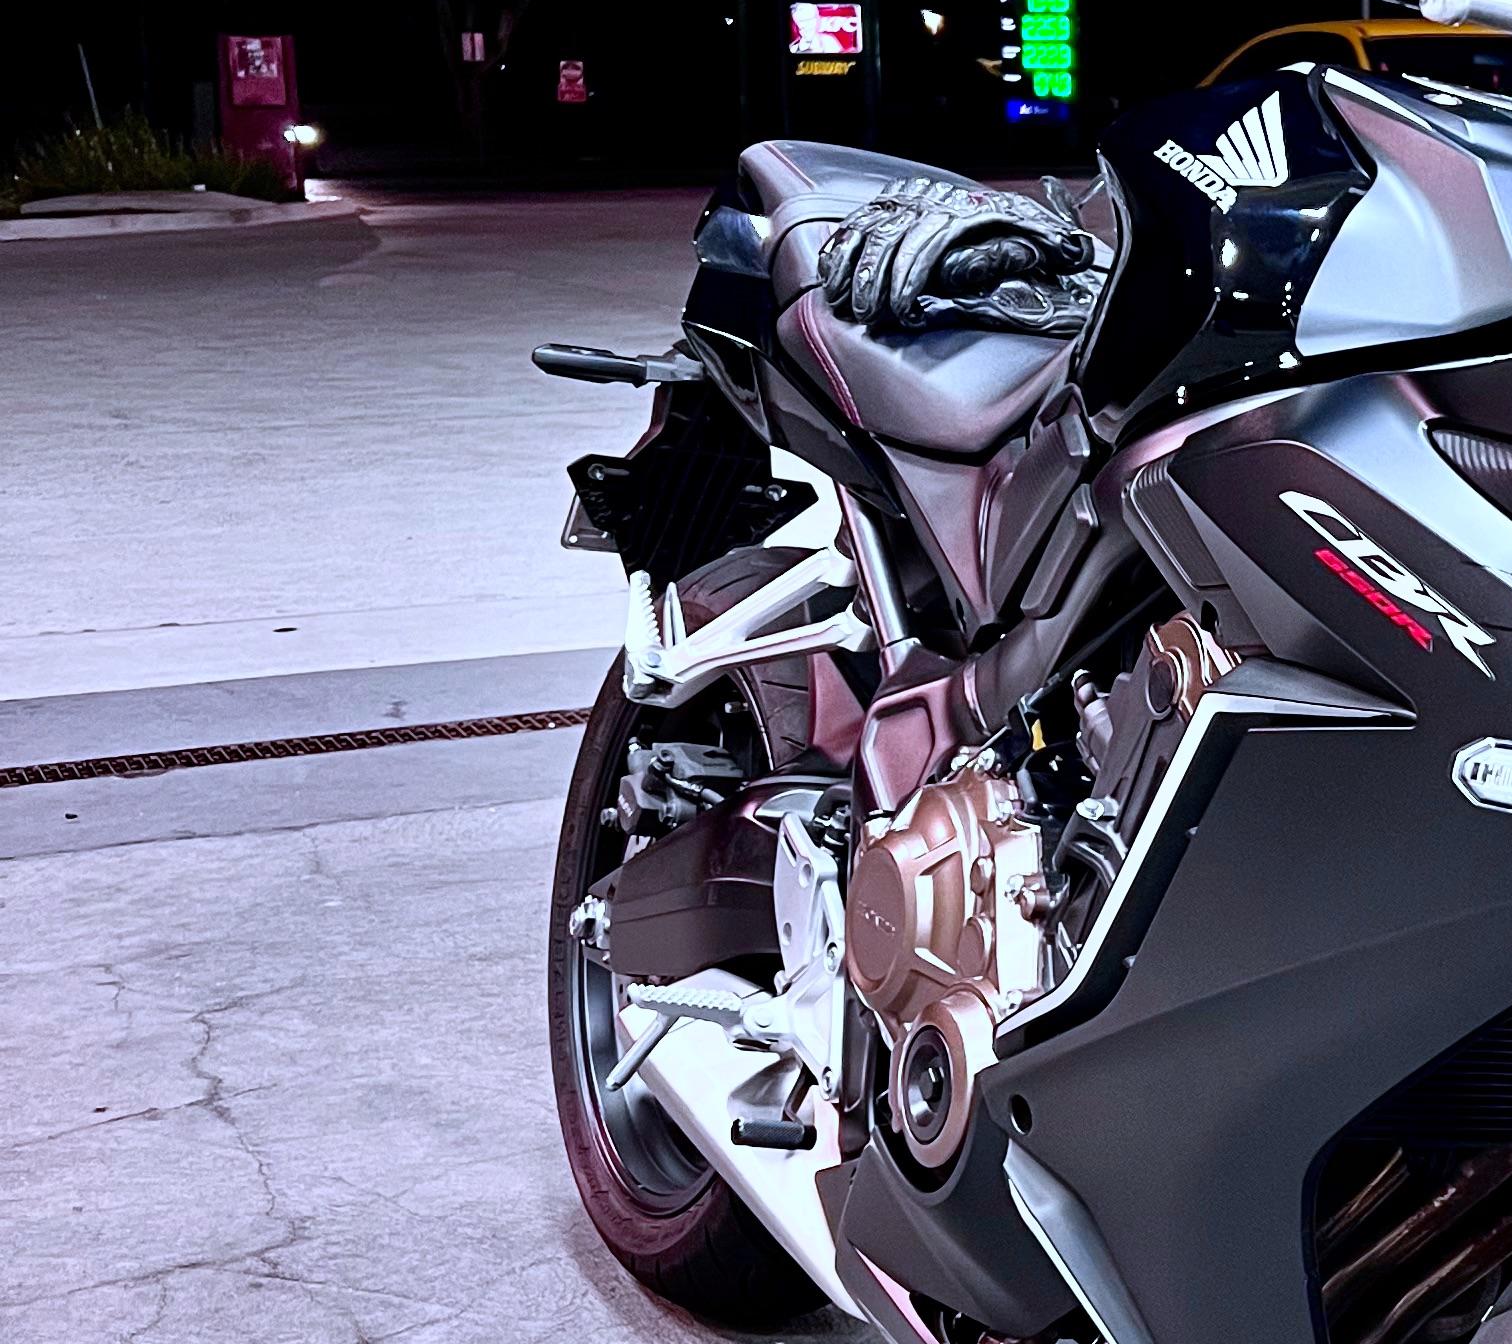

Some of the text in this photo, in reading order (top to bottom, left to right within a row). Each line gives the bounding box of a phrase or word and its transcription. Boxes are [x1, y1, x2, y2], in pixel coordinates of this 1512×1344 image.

[1153, 139, 1238, 214] HONDA
[1279, 490, 1496, 682] CBR
[1312, 547, 1434, 653] 650R
